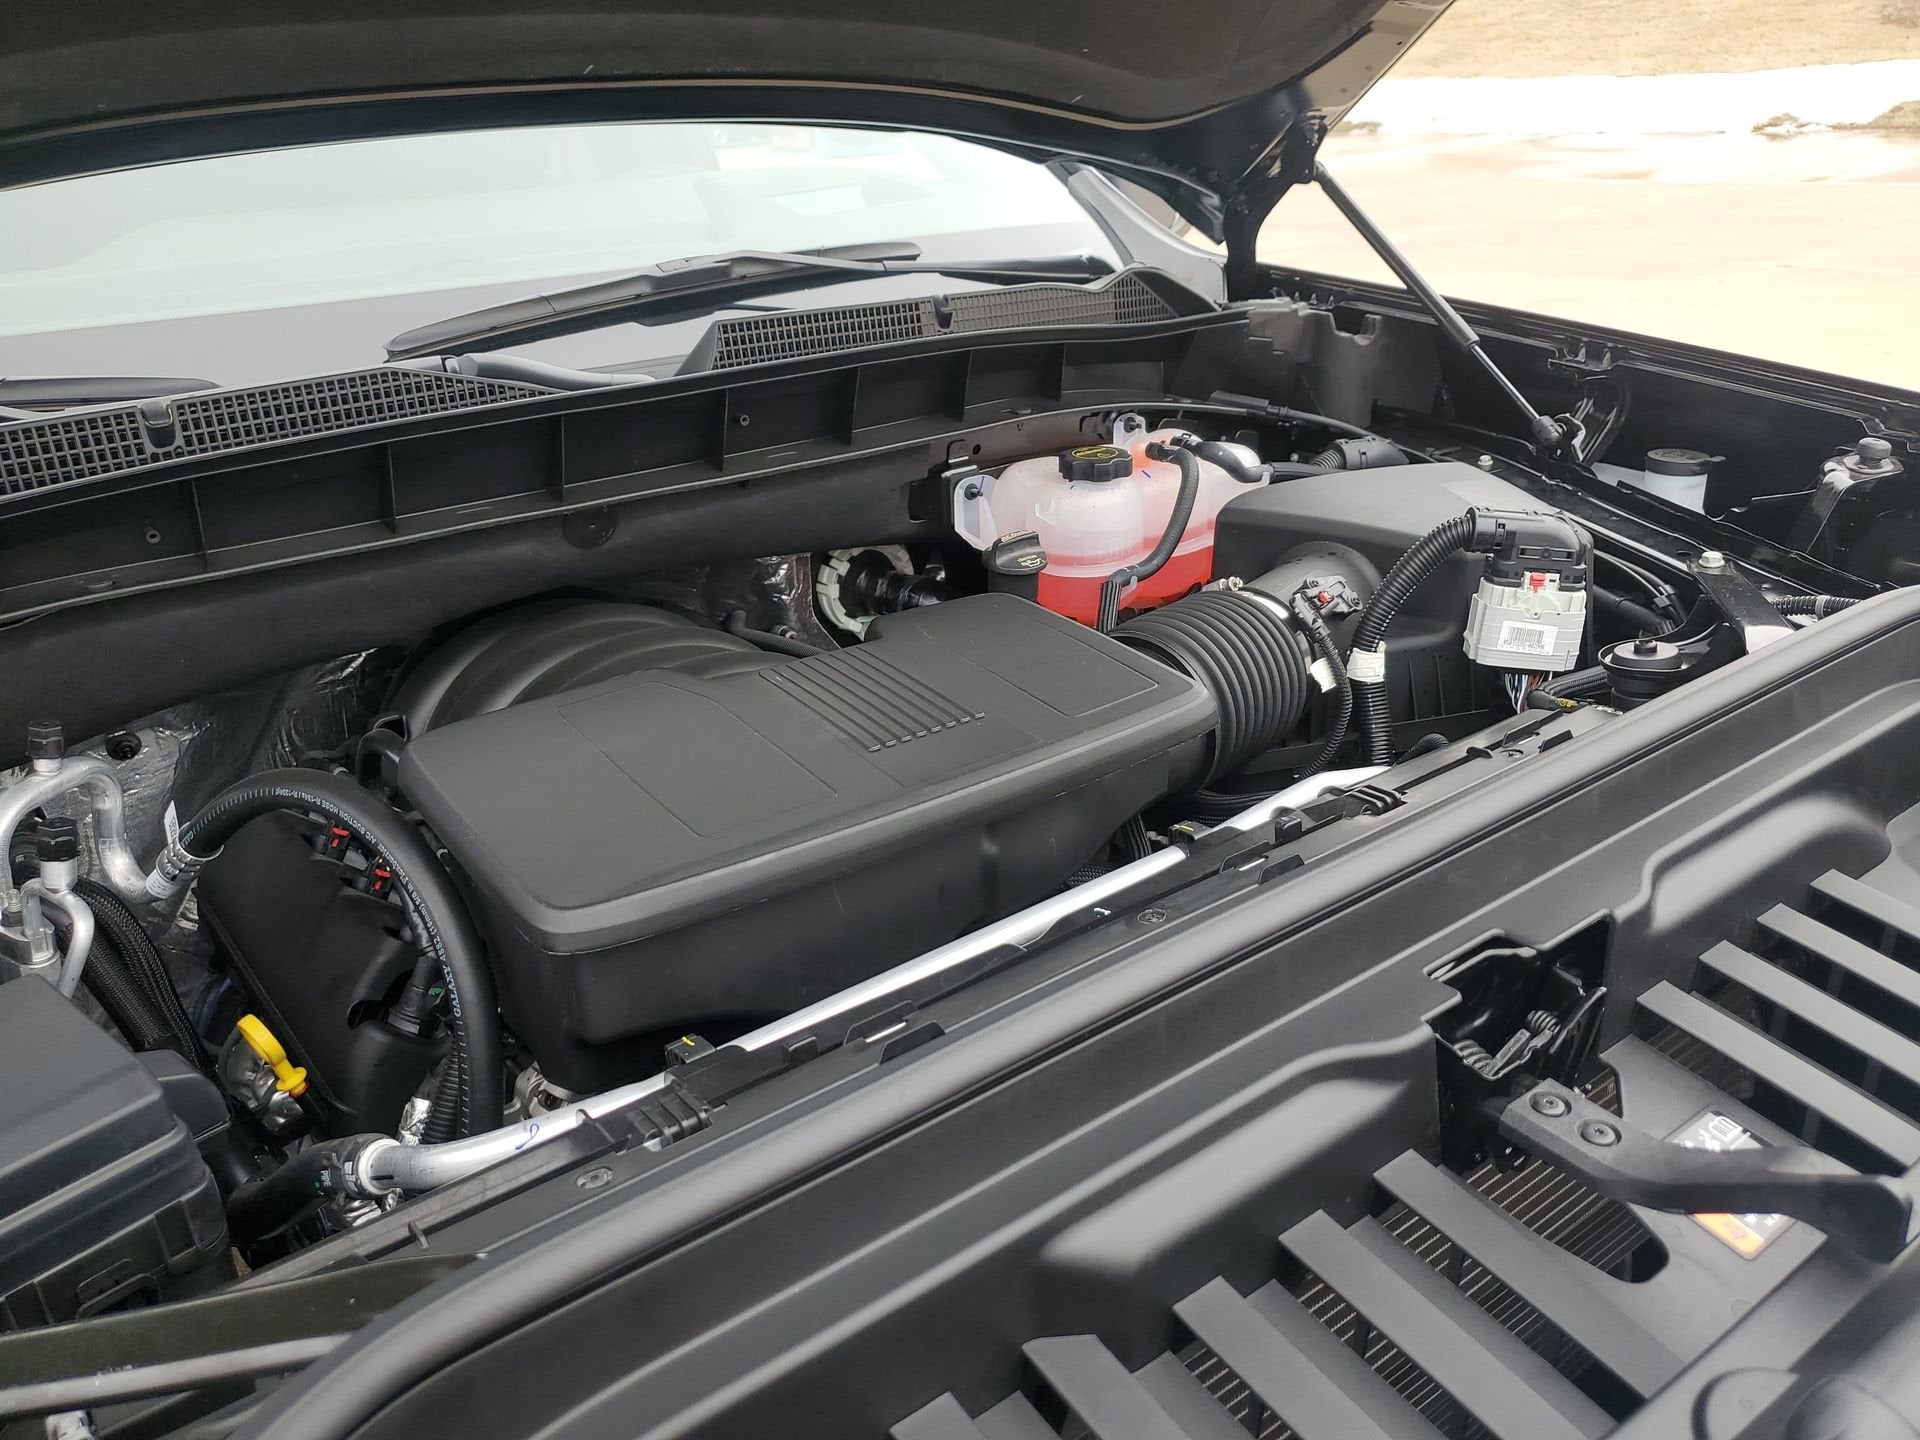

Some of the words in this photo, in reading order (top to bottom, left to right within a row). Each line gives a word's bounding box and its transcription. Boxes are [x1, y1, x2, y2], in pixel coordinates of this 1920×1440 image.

[321, 800, 339, 815] HOSE
[338, 809, 365, 835] SUCTION
[443, 965, 462, 1018] GALAXY
[320, 1169, 331, 1187] PIPE
